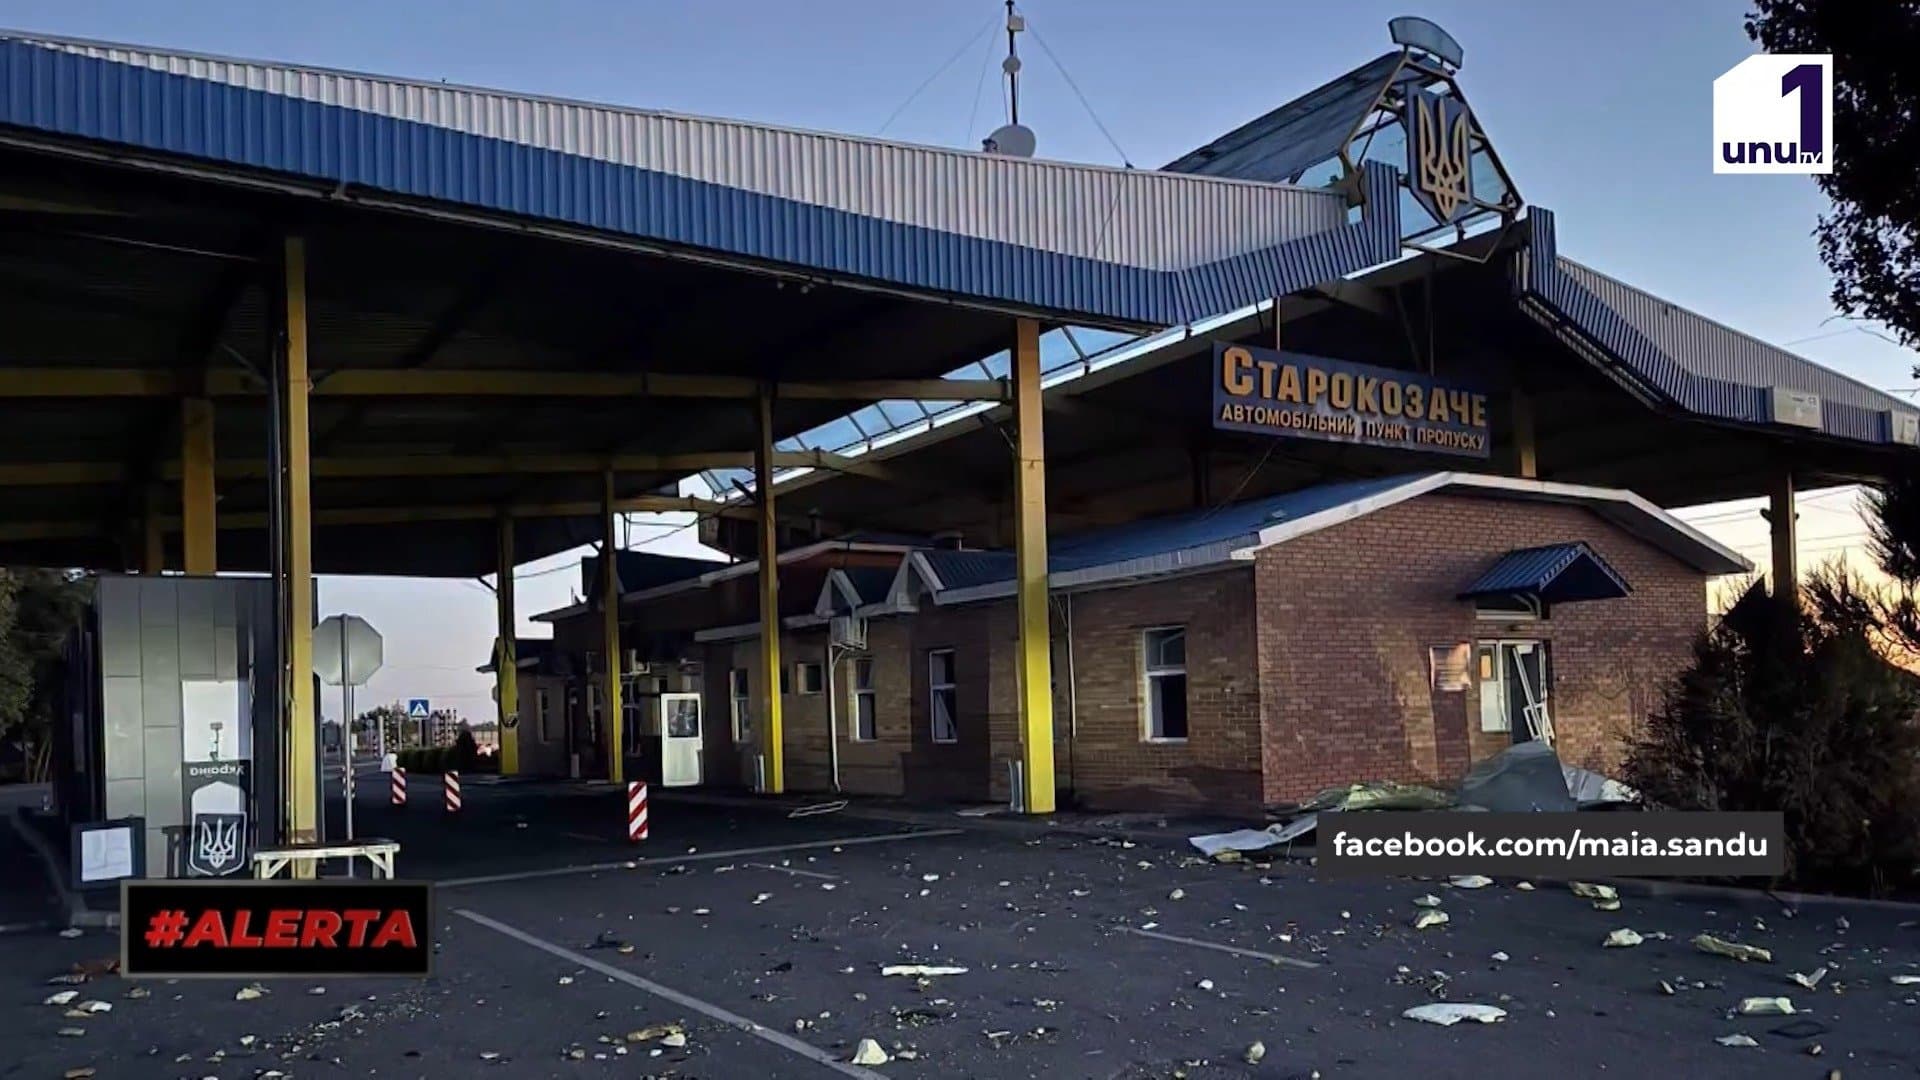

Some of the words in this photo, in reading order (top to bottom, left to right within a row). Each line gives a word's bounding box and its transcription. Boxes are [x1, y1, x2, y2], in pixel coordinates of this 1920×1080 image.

[1222, 404, 1357, 434] АВТОМОБІЛЬНИЙ
[1366, 421, 1411, 441] ПУНКТ
[1417, 426, 1485, 450] ПРОПУСКУ
